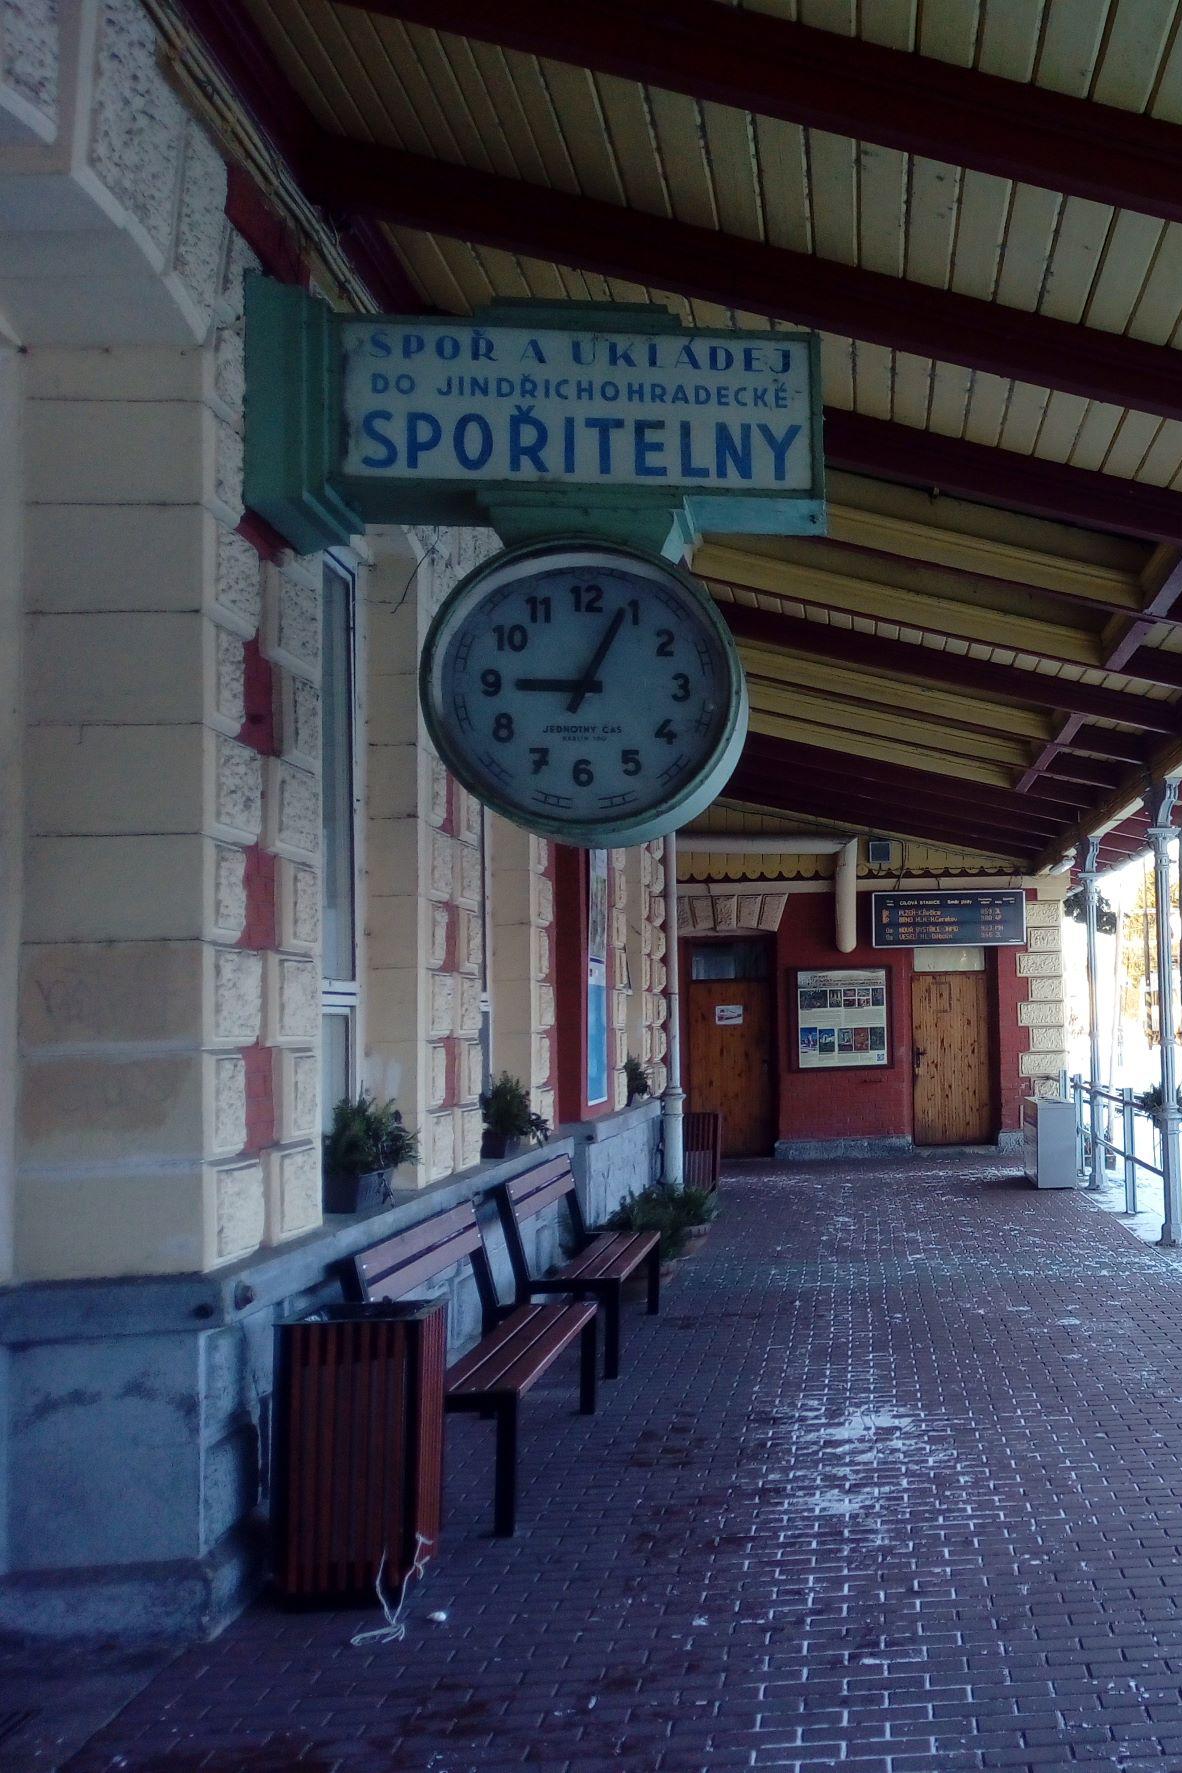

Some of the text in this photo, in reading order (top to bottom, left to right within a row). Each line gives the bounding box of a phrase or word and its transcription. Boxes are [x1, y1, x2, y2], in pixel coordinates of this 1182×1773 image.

[369, 329, 791, 374] SPOŘ A UKLÁDEJ
[371, 372, 789, 409] DO JINDŘICHOHRADECKÉ
[361, 404, 803, 481] SPOŘITELNY
[525, 596, 552, 624] 11
[570, 584, 604, 613] 12
[627, 598, 640, 626] 1
[492, 623, 529, 652] 10
[656, 628, 675, 657] 2
[480, 668, 502, 697] 9
[671, 672, 691, 702] 3
[492, 712, 514, 743] 8
[654, 718, 677, 745] 4
[529, 747, 549, 775] 7
[572, 758, 594, 787] 6
[621, 749, 642, 777] 5
